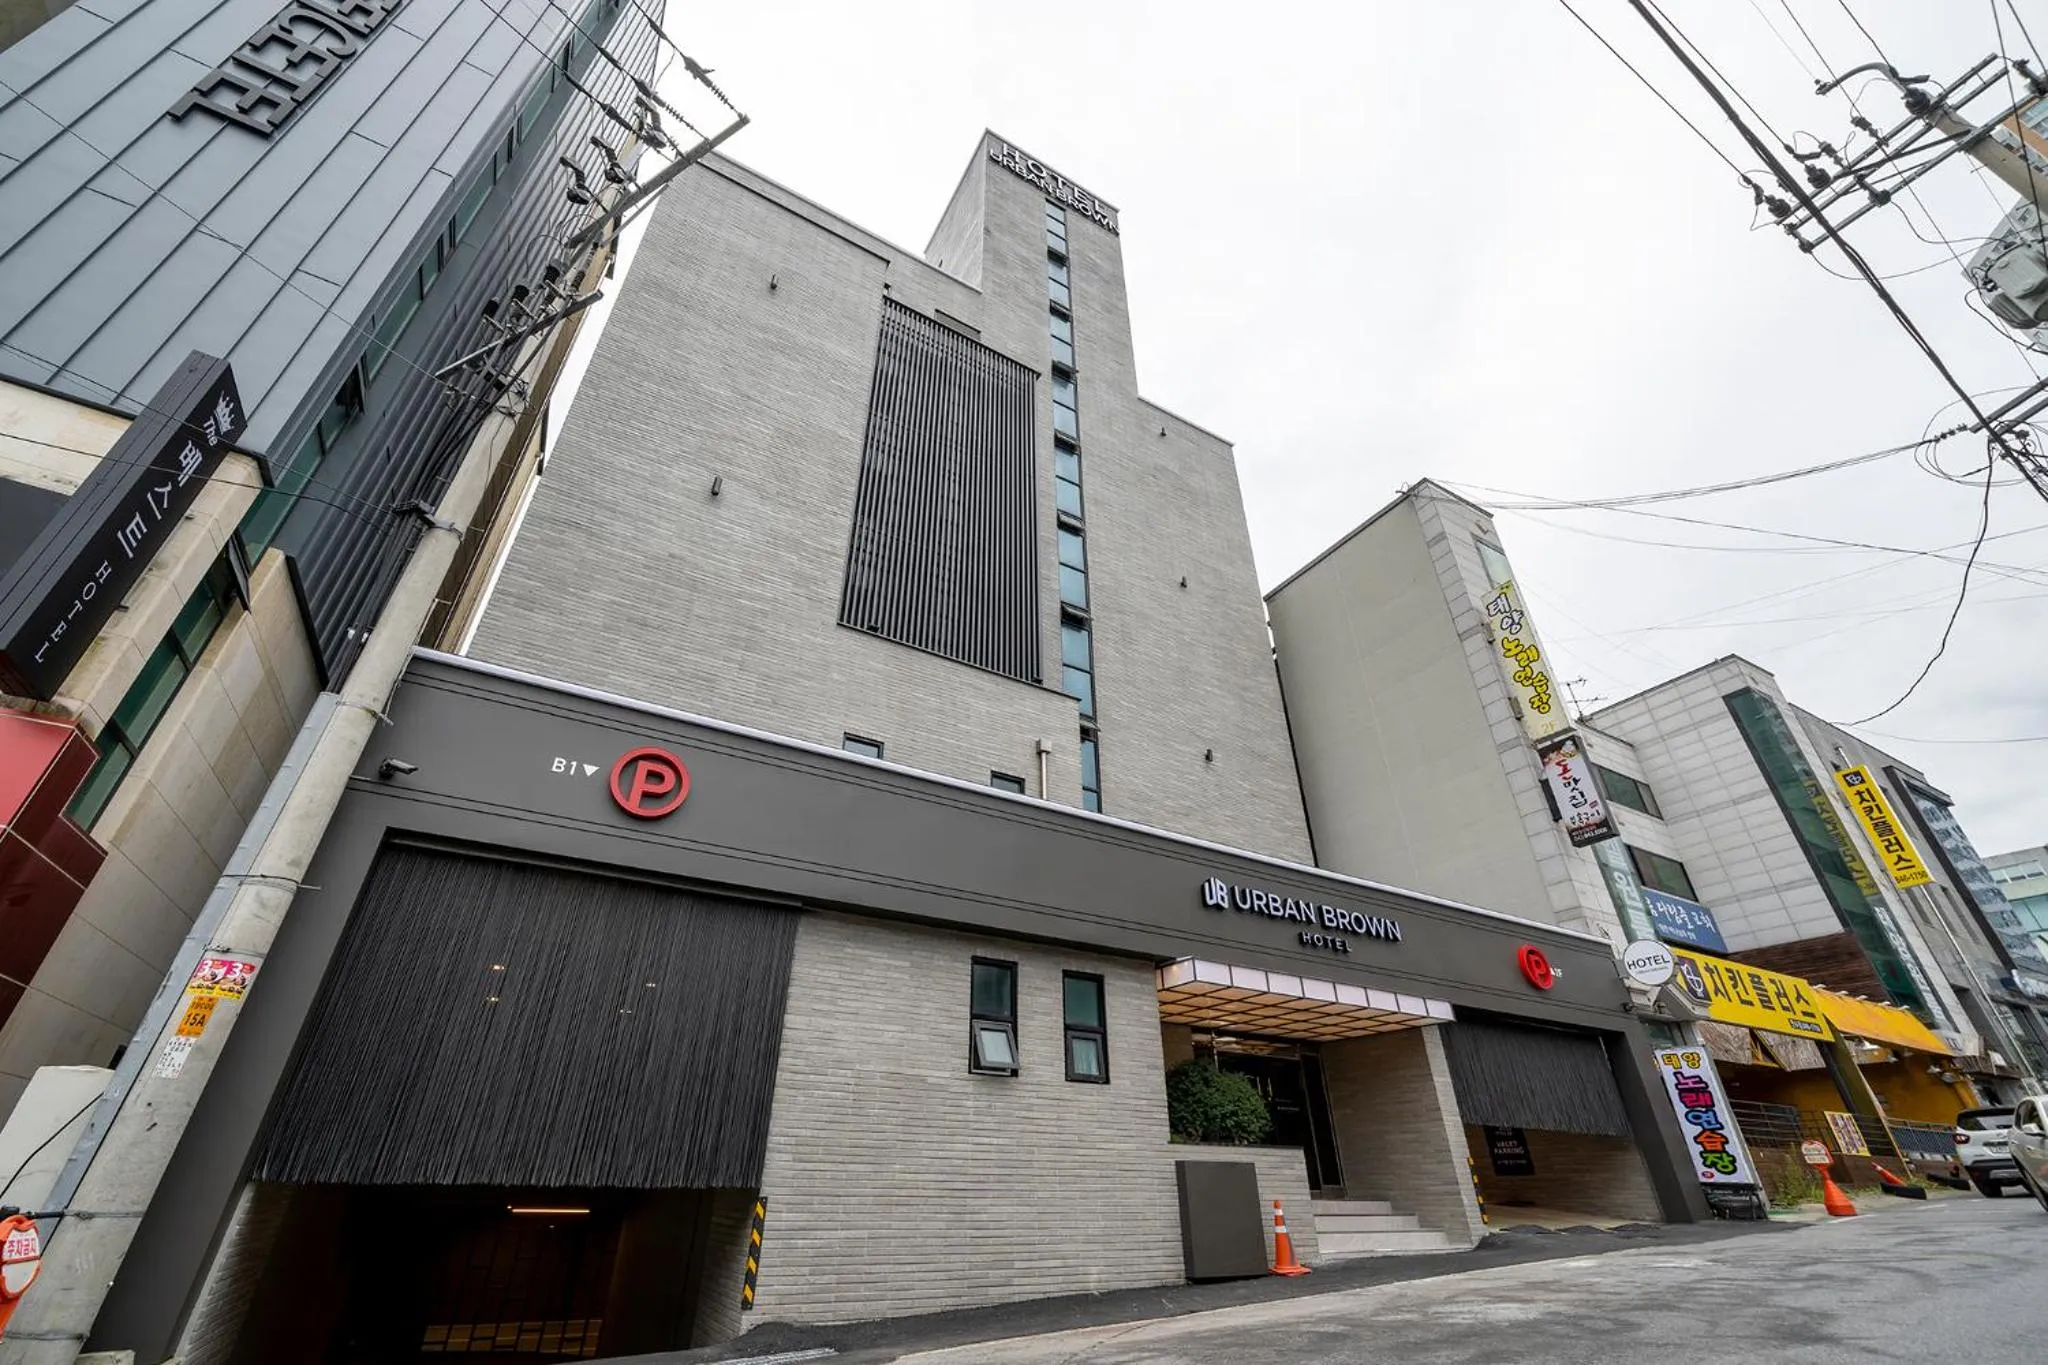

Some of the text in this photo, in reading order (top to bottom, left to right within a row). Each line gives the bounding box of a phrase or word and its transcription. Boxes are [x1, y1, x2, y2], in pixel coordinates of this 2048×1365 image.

[989, 148, 1120, 234] URBAN BROWN
[1002, 142, 1107, 214] HOTEL
[203, 418, 219, 447] The
[116, 440, 203, 559] 베스트
[34, 559, 113, 664] HOTEL
[1487, 592, 1552, 715] 태양 노래연습장
[551, 757, 577, 776] B1
[1854, 787, 1917, 872] 치킨플러스
[1234, 884, 1317, 925] URBAN
[1322, 904, 1403, 942] BROWN
[1302, 930, 1354, 952] HOTEL
[1627, 954, 1671, 970] HOTEL
[1703, 962, 1817, 1018] 치킨플러스
[185, 1012, 206, 1027] 15A
[1662, 1051, 1701, 1070] 태양
[1673, 1070, 1738, 1176] 노래연습장
